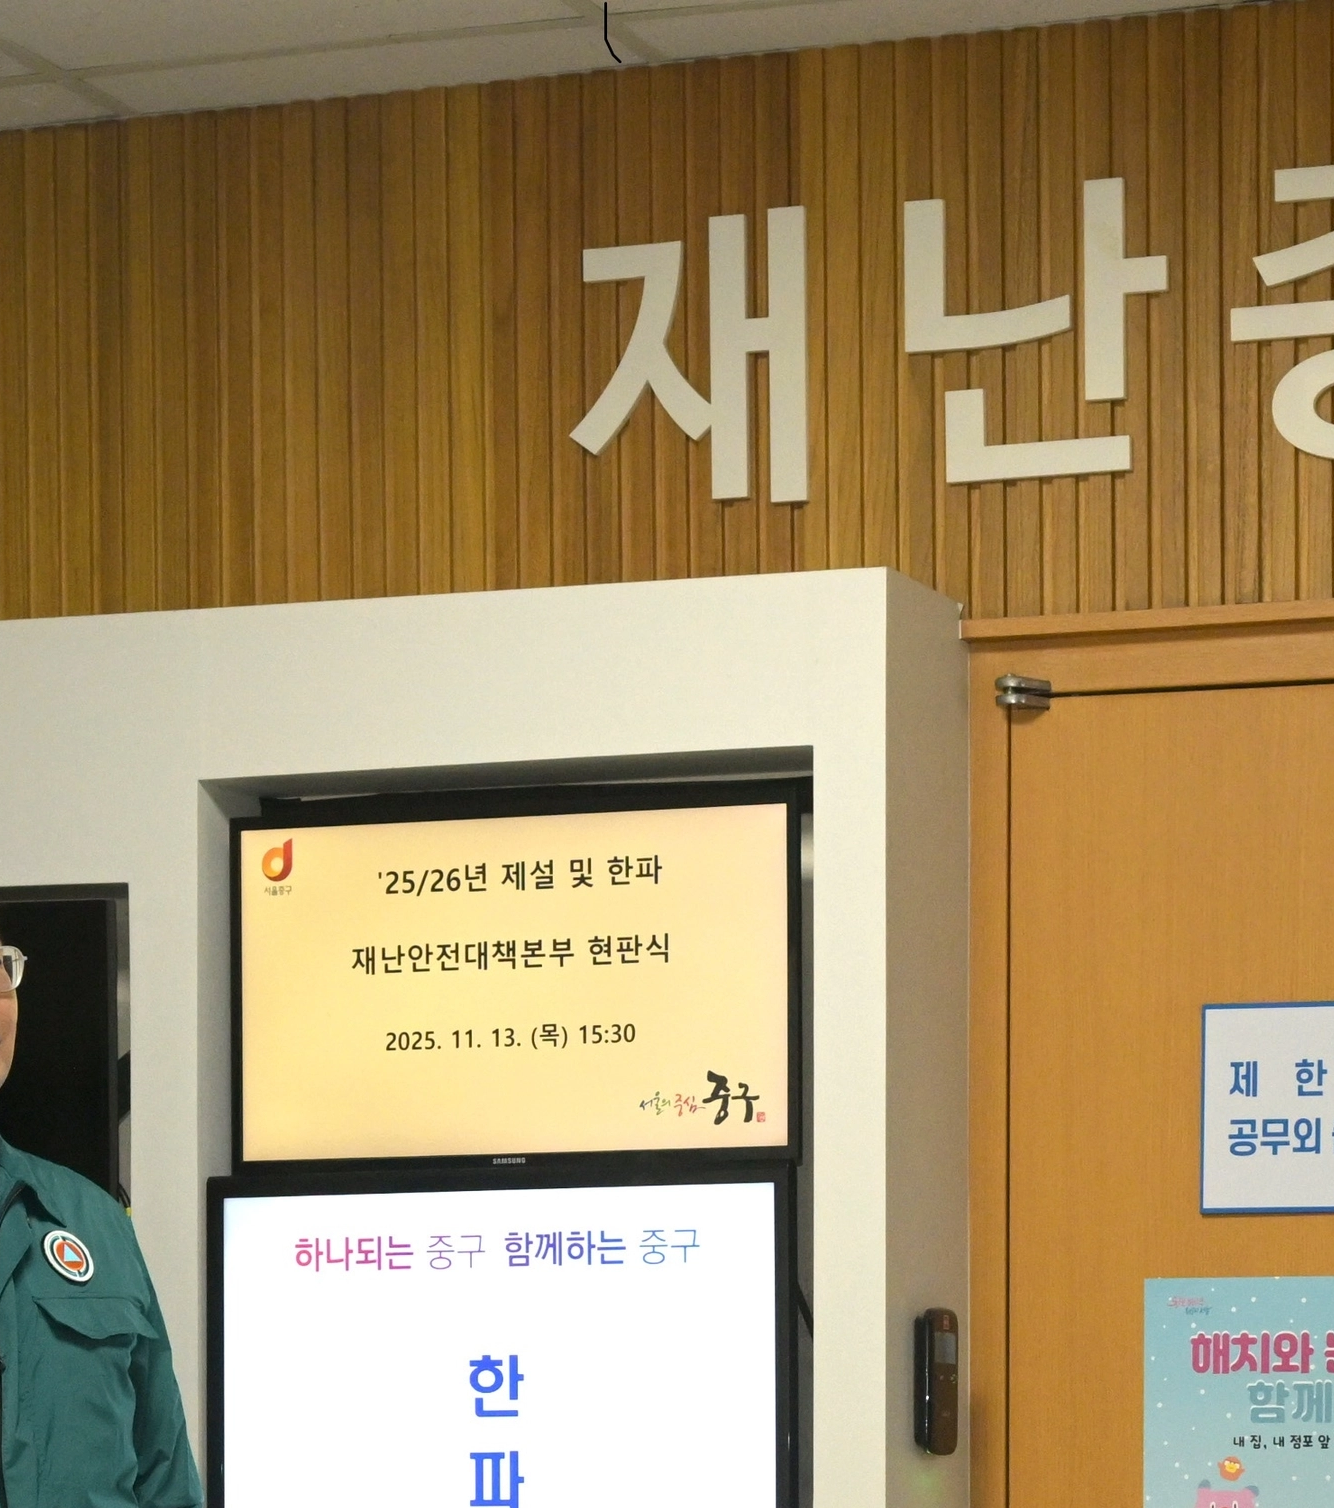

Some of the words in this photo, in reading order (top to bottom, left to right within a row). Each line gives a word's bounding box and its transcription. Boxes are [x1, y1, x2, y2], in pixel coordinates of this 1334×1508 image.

[377, 862, 488, 897] '25/26년
[501, 858, 556, 891] 제설
[570, 857, 594, 889] 및
[607, 853, 663, 886] 한파
[351, 937, 575, 975] 재난안전대책본부
[587, 932, 671, 967] 현판식
[385, 1030, 442, 1052] 2025.
[451, 1029, 482, 1050] 11.
[491, 1027, 522, 1048] 13.
[530, 1022, 569, 1050] (목)
[579, 1023, 637, 1045] 15:30
[702, 1070, 760, 1125] 중구
[1228, 1117, 1322, 1157] 공무외
[492, 1157, 526, 1165] SAMSUNG
[294, 1235, 414, 1272] 하나되는
[426, 1233, 487, 1271] 중구
[504, 1230, 627, 1267] 함께하는
[638, 1228, 701, 1265] 중구
[1190, 1329, 1315, 1374] 해치와
[1233, 1435, 1245, 1449] 내
[1250, 1435, 1267, 1450] 집,
[1273, 1435, 1285, 1449] 내
[1290, 1434, 1314, 1449] 점포
[1318, 1434, 1331, 1449] 앞
